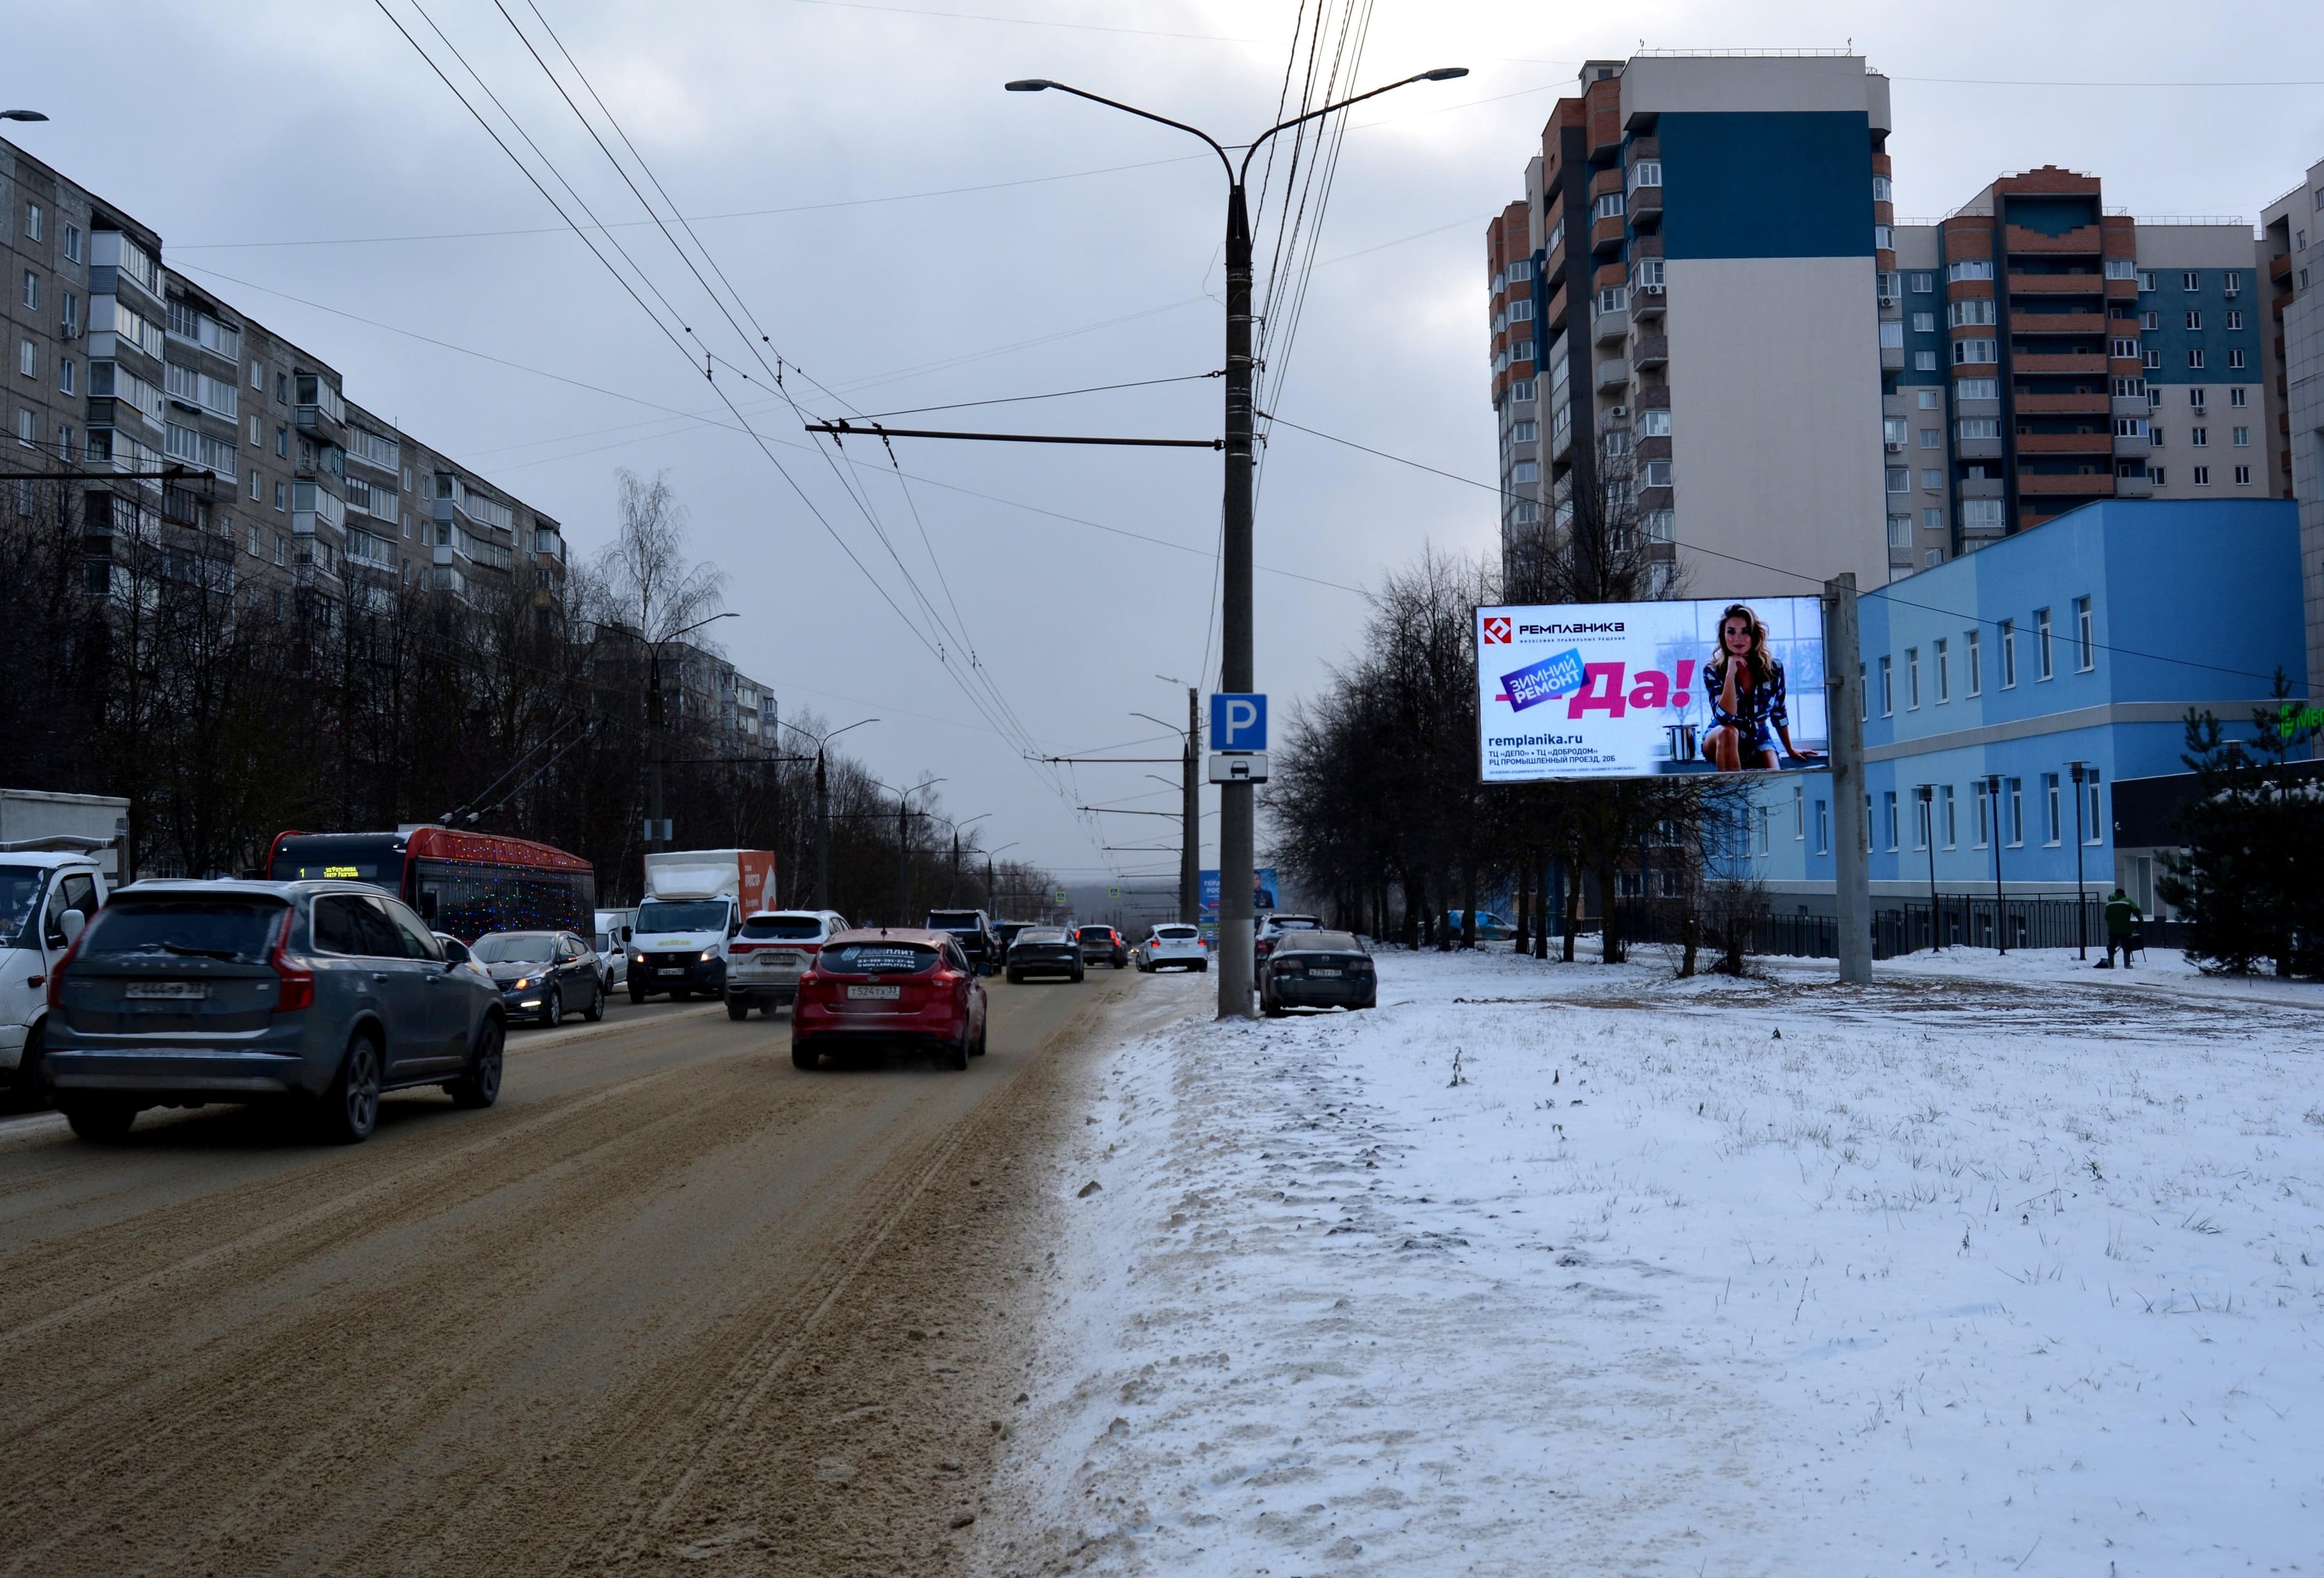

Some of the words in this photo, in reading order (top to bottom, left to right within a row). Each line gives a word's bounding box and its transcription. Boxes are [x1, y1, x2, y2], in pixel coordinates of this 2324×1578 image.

[1509, 655, 1578, 690] ЗИМНИЙ
[1514, 670, 1579, 704] РЕМОНТ
[1567, 659, 1695, 719] Да!
[1488, 734, 1583, 747] remplanika.ru
[1501, 756, 1567, 765] ПРОМЫШЛЕННЫЙ
[300, 868, 304, 877] 1
